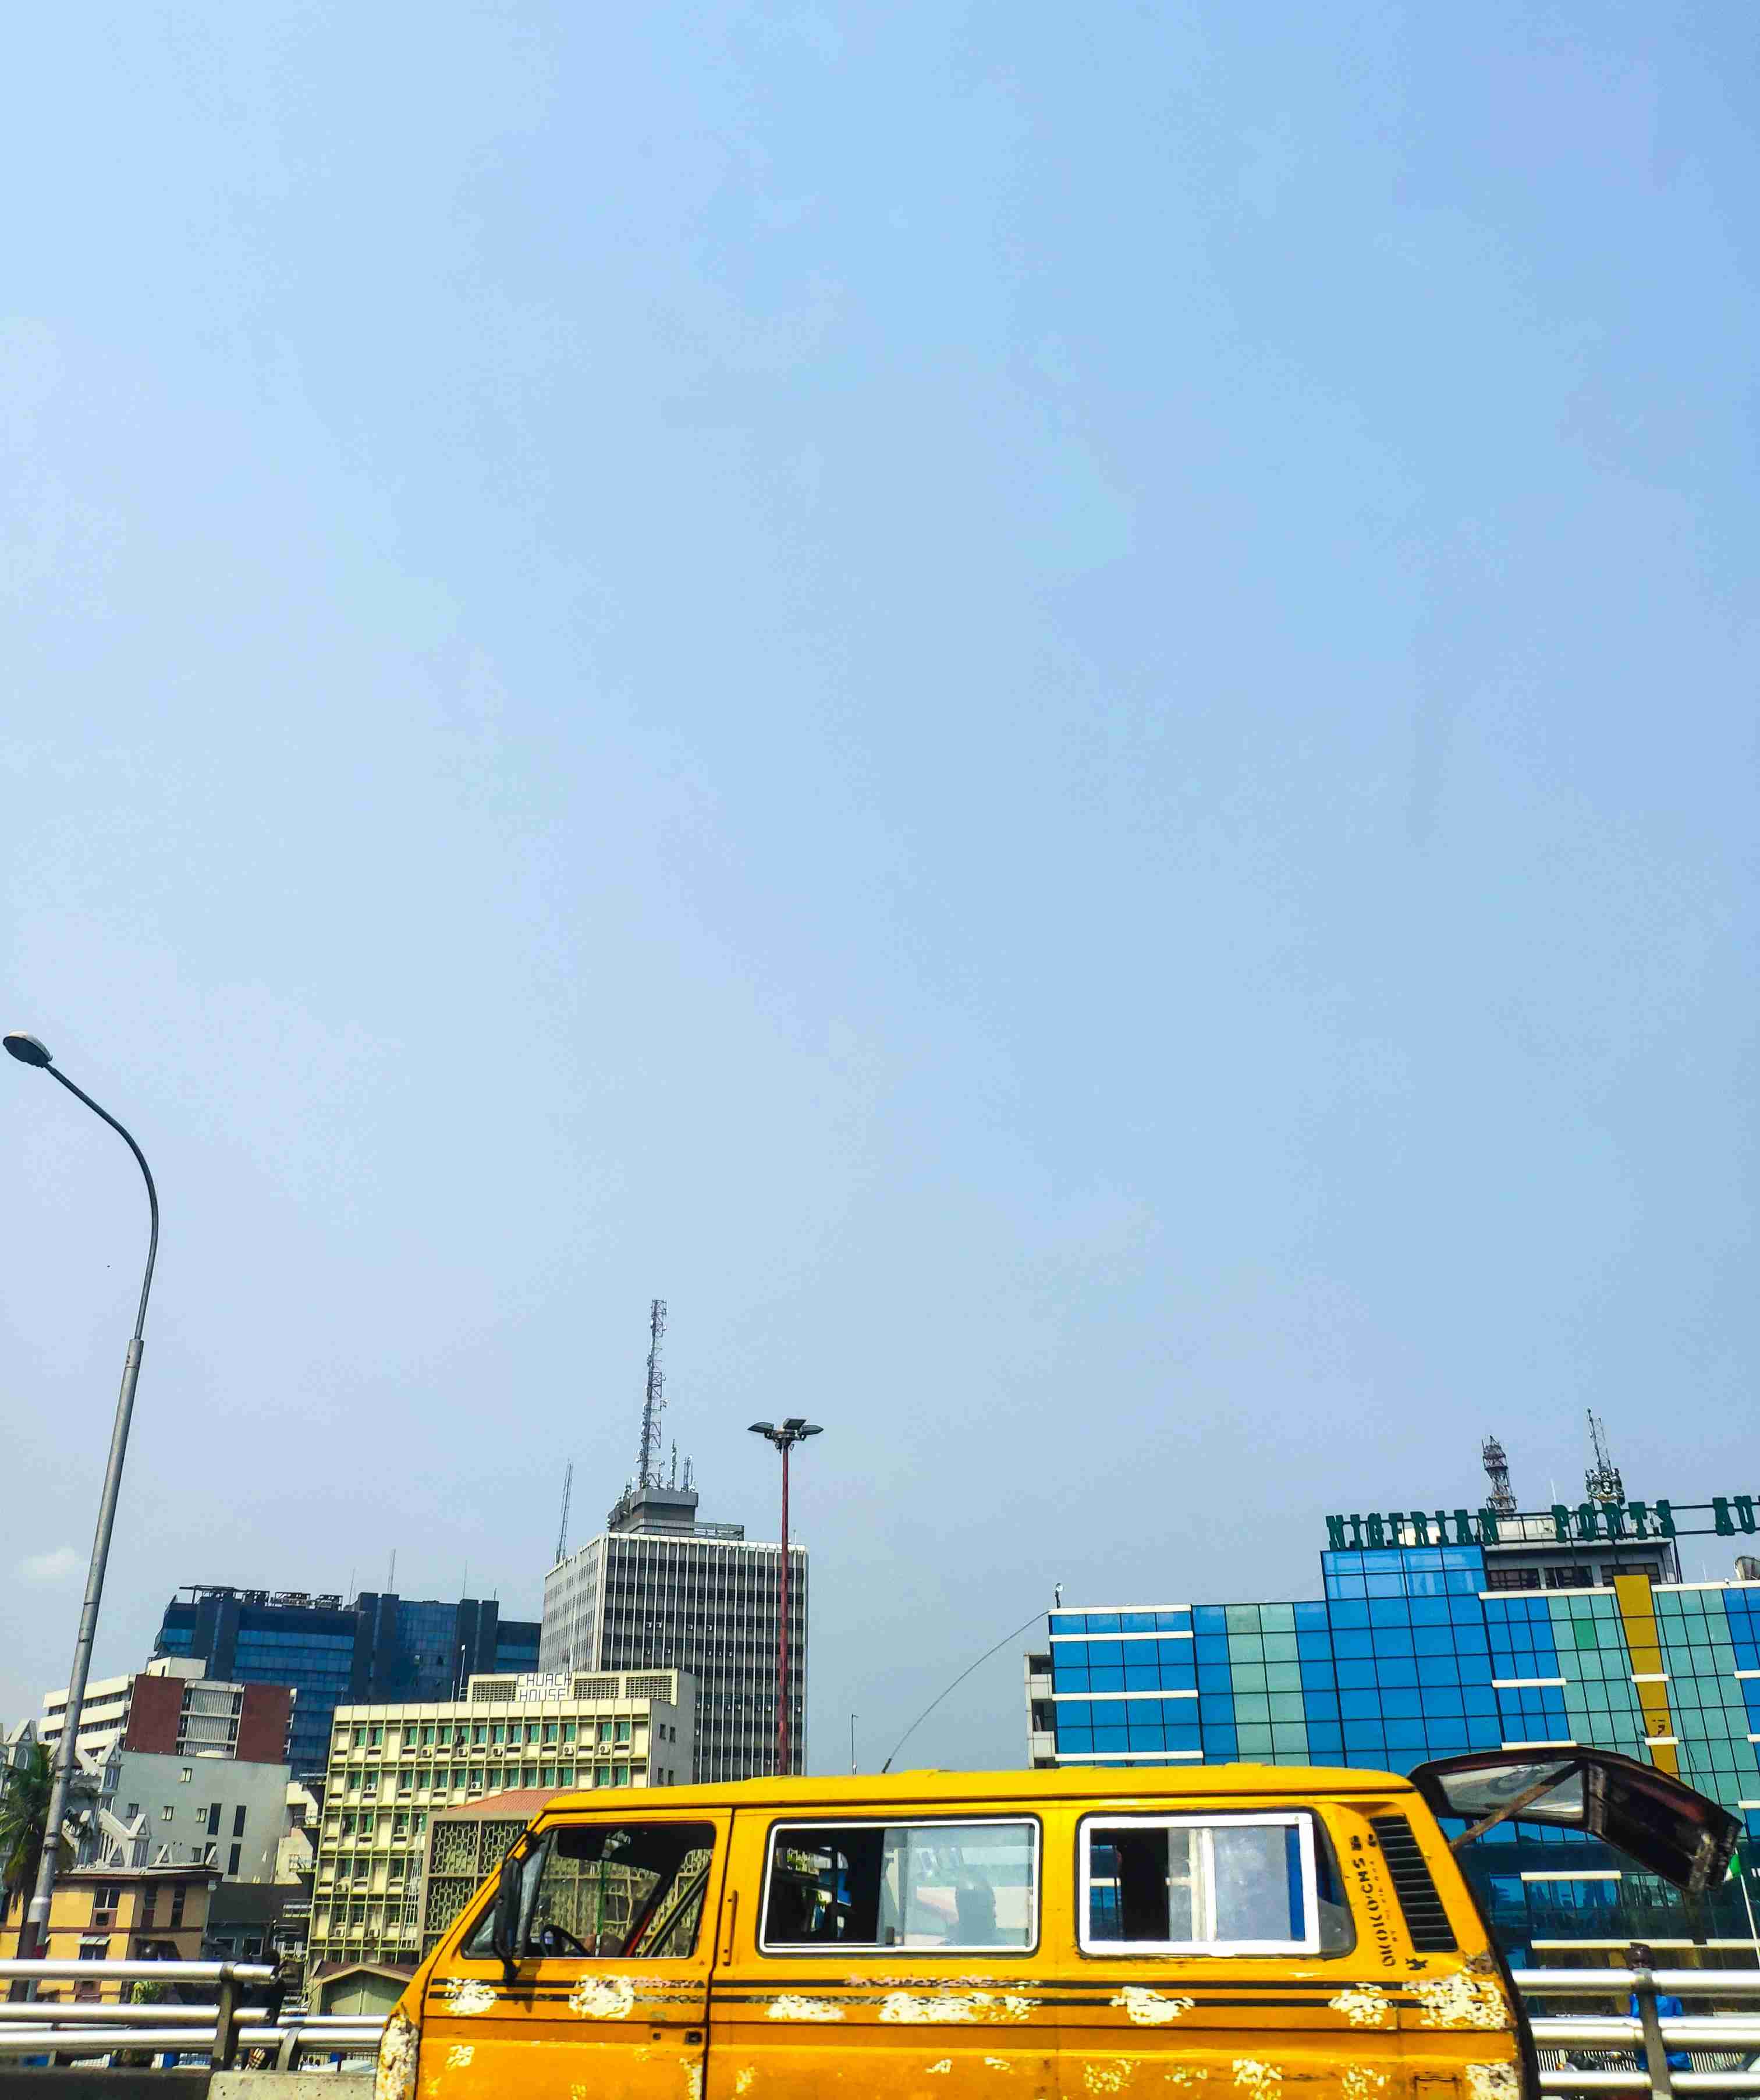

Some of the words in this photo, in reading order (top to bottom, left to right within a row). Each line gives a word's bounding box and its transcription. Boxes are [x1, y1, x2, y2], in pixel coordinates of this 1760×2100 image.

[1325, 1507, 1500, 1552] NIGERIAN
[1551, 1499, 1676, 1543] PORTS
[1712, 1495, 1760, 1536] AU
[520, 1688, 566, 1702] HOUSE
